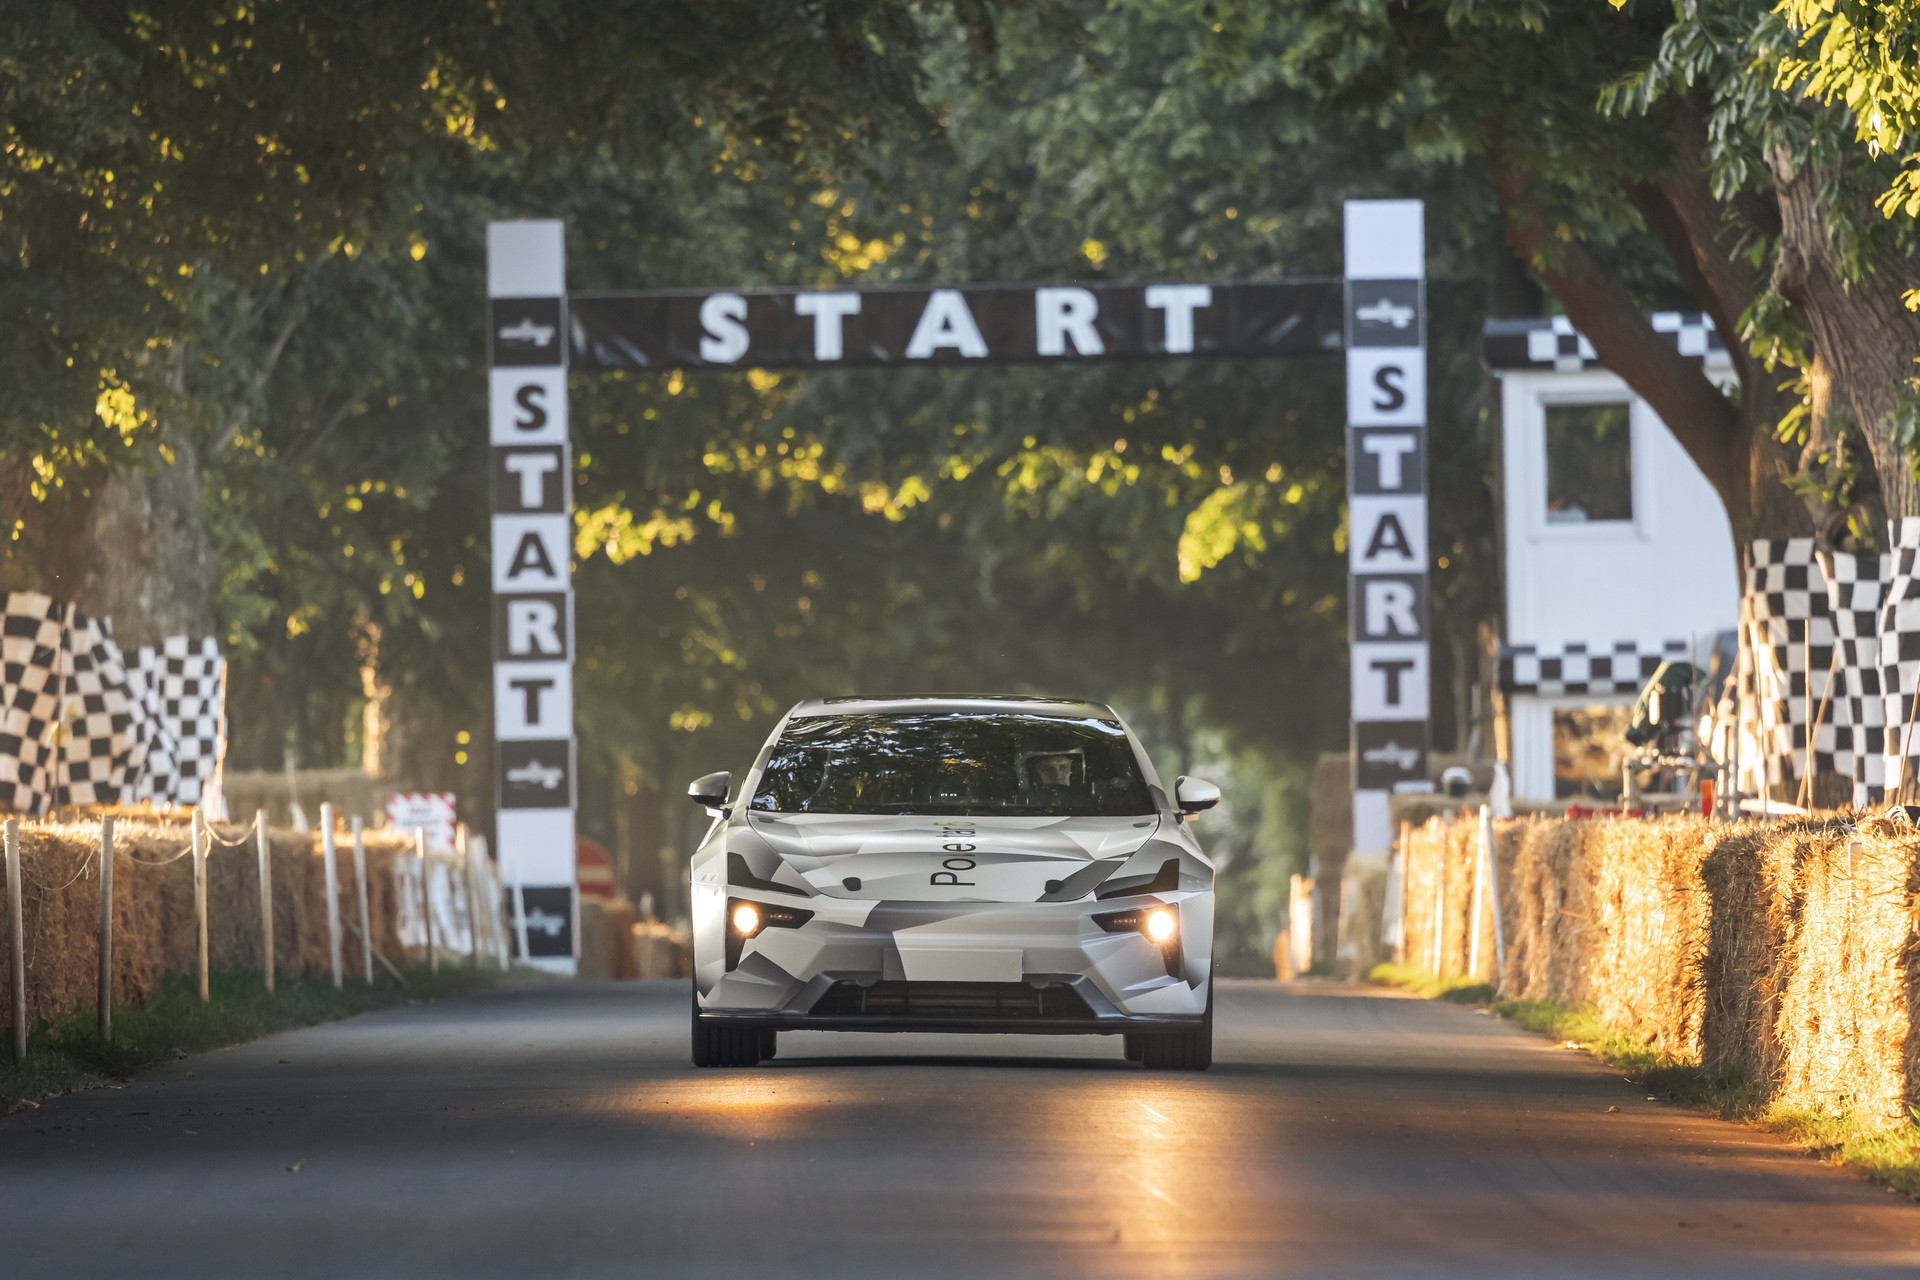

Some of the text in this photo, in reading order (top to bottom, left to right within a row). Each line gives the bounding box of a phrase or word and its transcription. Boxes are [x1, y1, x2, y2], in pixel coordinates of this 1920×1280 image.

[699, 284, 1212, 363] START
[508, 385, 562, 725] START
[1363, 366, 1420, 706] START
[930, 827, 976, 886] Poletar
